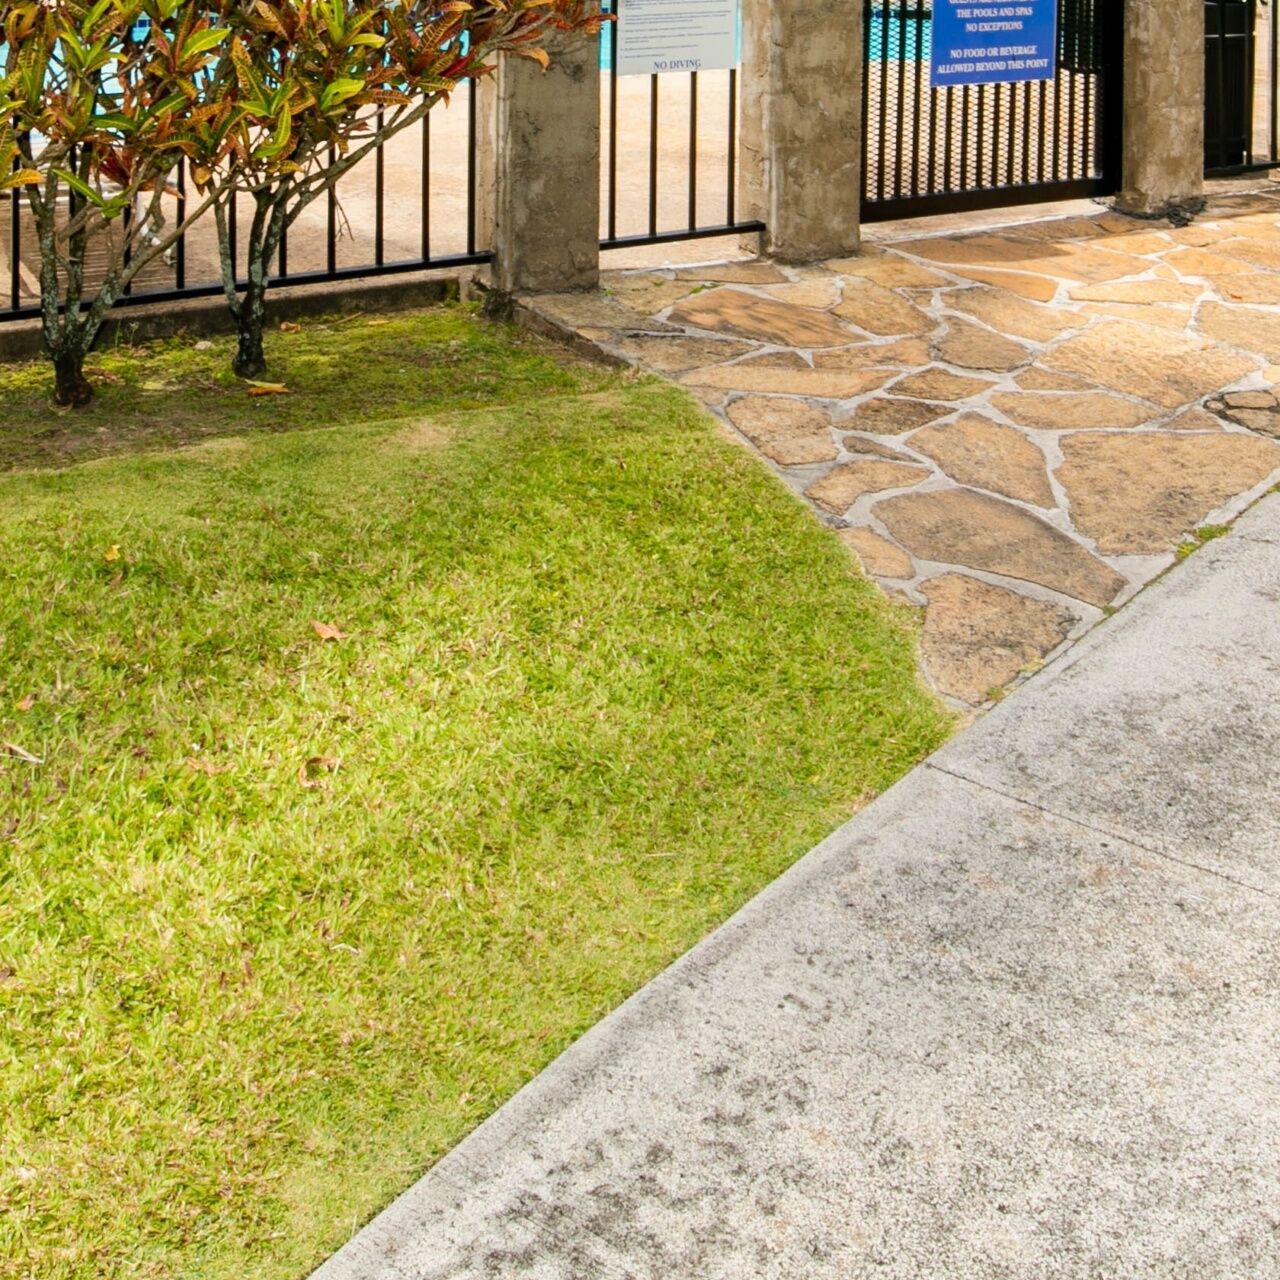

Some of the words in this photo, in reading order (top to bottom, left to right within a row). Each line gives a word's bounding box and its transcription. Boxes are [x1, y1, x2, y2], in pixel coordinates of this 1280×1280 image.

[956, 8, 973, 18] THE
[973, 8, 998, 17] POOLS
[998, 7, 1014, 16] AND
[1015, 6, 1033, 15] SPAS
[966, 23, 977, 32] NO
[979, 21, 1023, 31] EXCEPTIONS
[950, 49, 962, 58] NO
[963, 48, 986, 58] FOOD
[987, 47, 998, 57] OR
[1000, 45, 1037, 56] BEVERAGE
[654, 61, 667, 70] NO
[669, 59, 701, 69] DIVING
[937, 63, 974, 74] ALLOWED
[976, 61, 1006, 72] BEYOND
[1007, 60, 1024, 70] THIS
[1026, 58, 1049, 68] POINT
